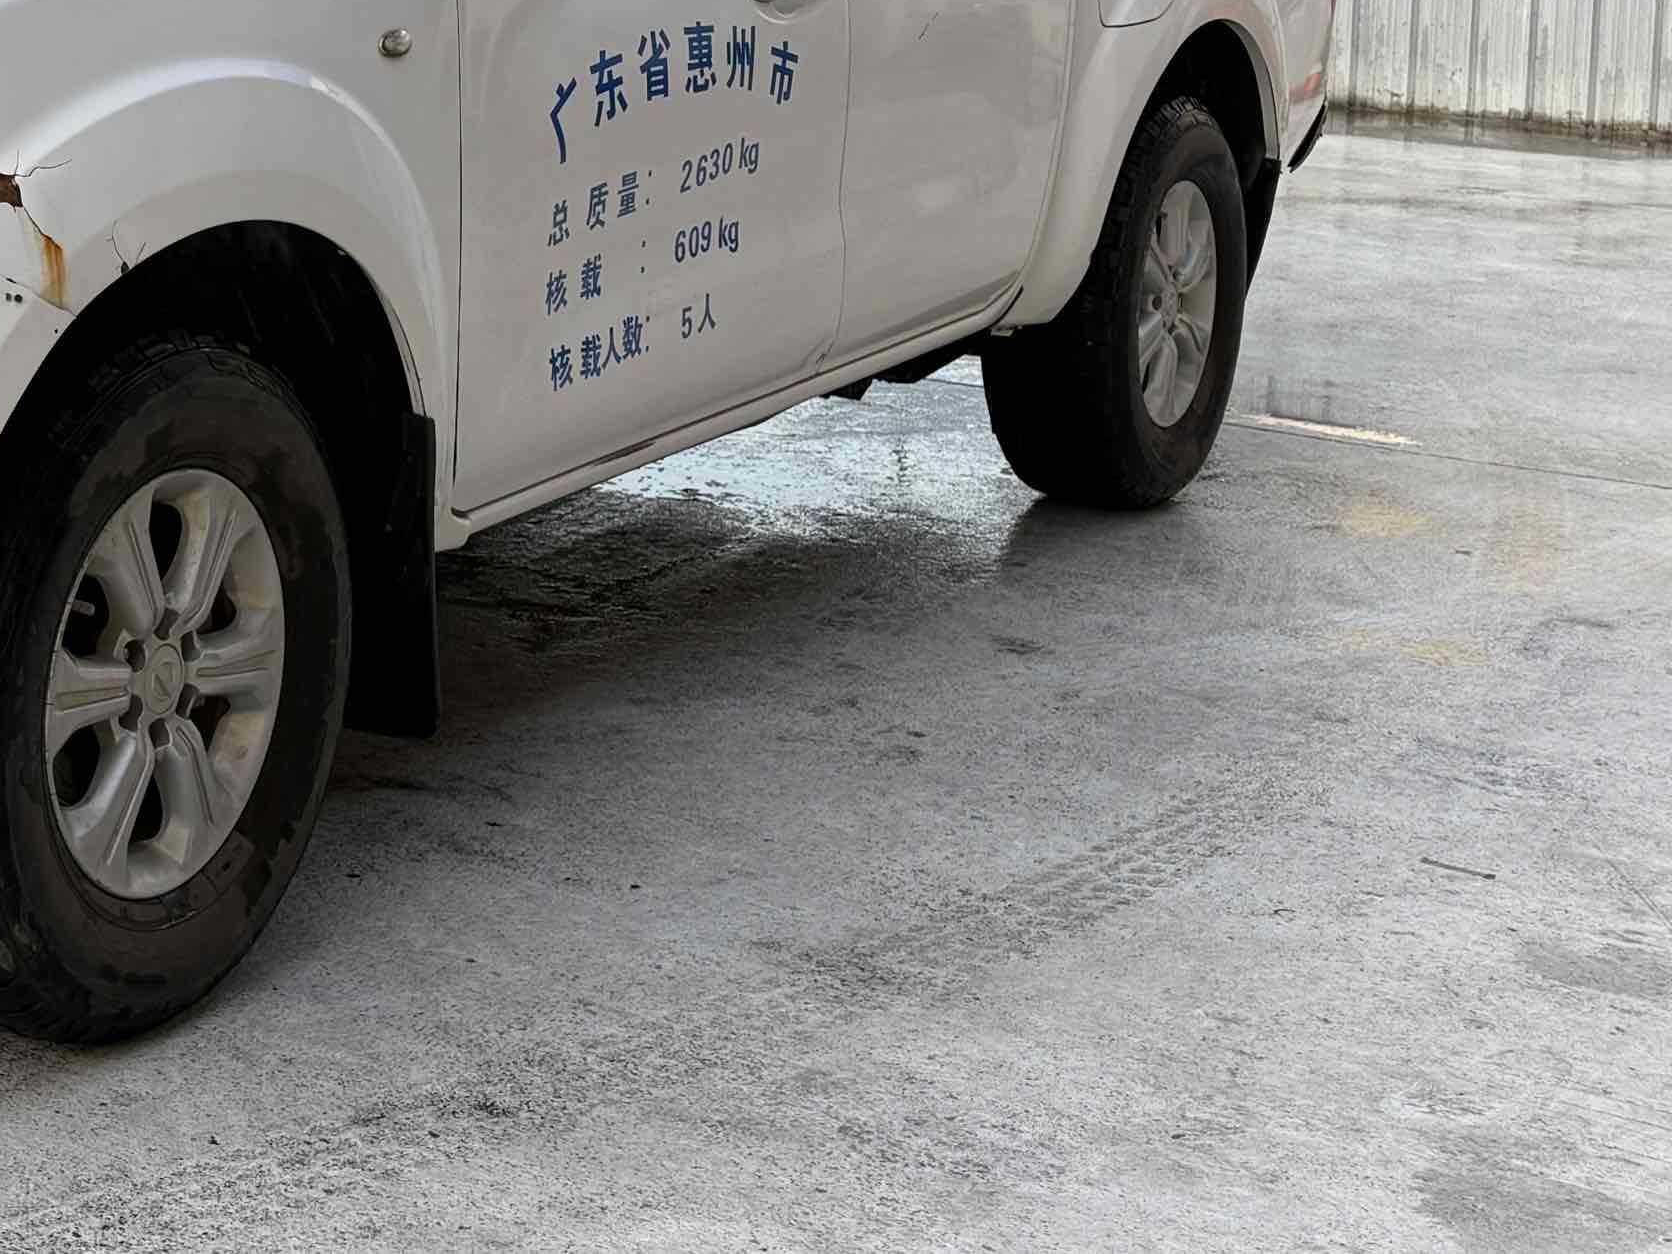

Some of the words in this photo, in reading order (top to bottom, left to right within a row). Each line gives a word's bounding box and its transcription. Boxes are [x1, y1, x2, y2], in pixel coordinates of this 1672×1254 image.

[549, 20, 799, 165] 广东省惠州市
